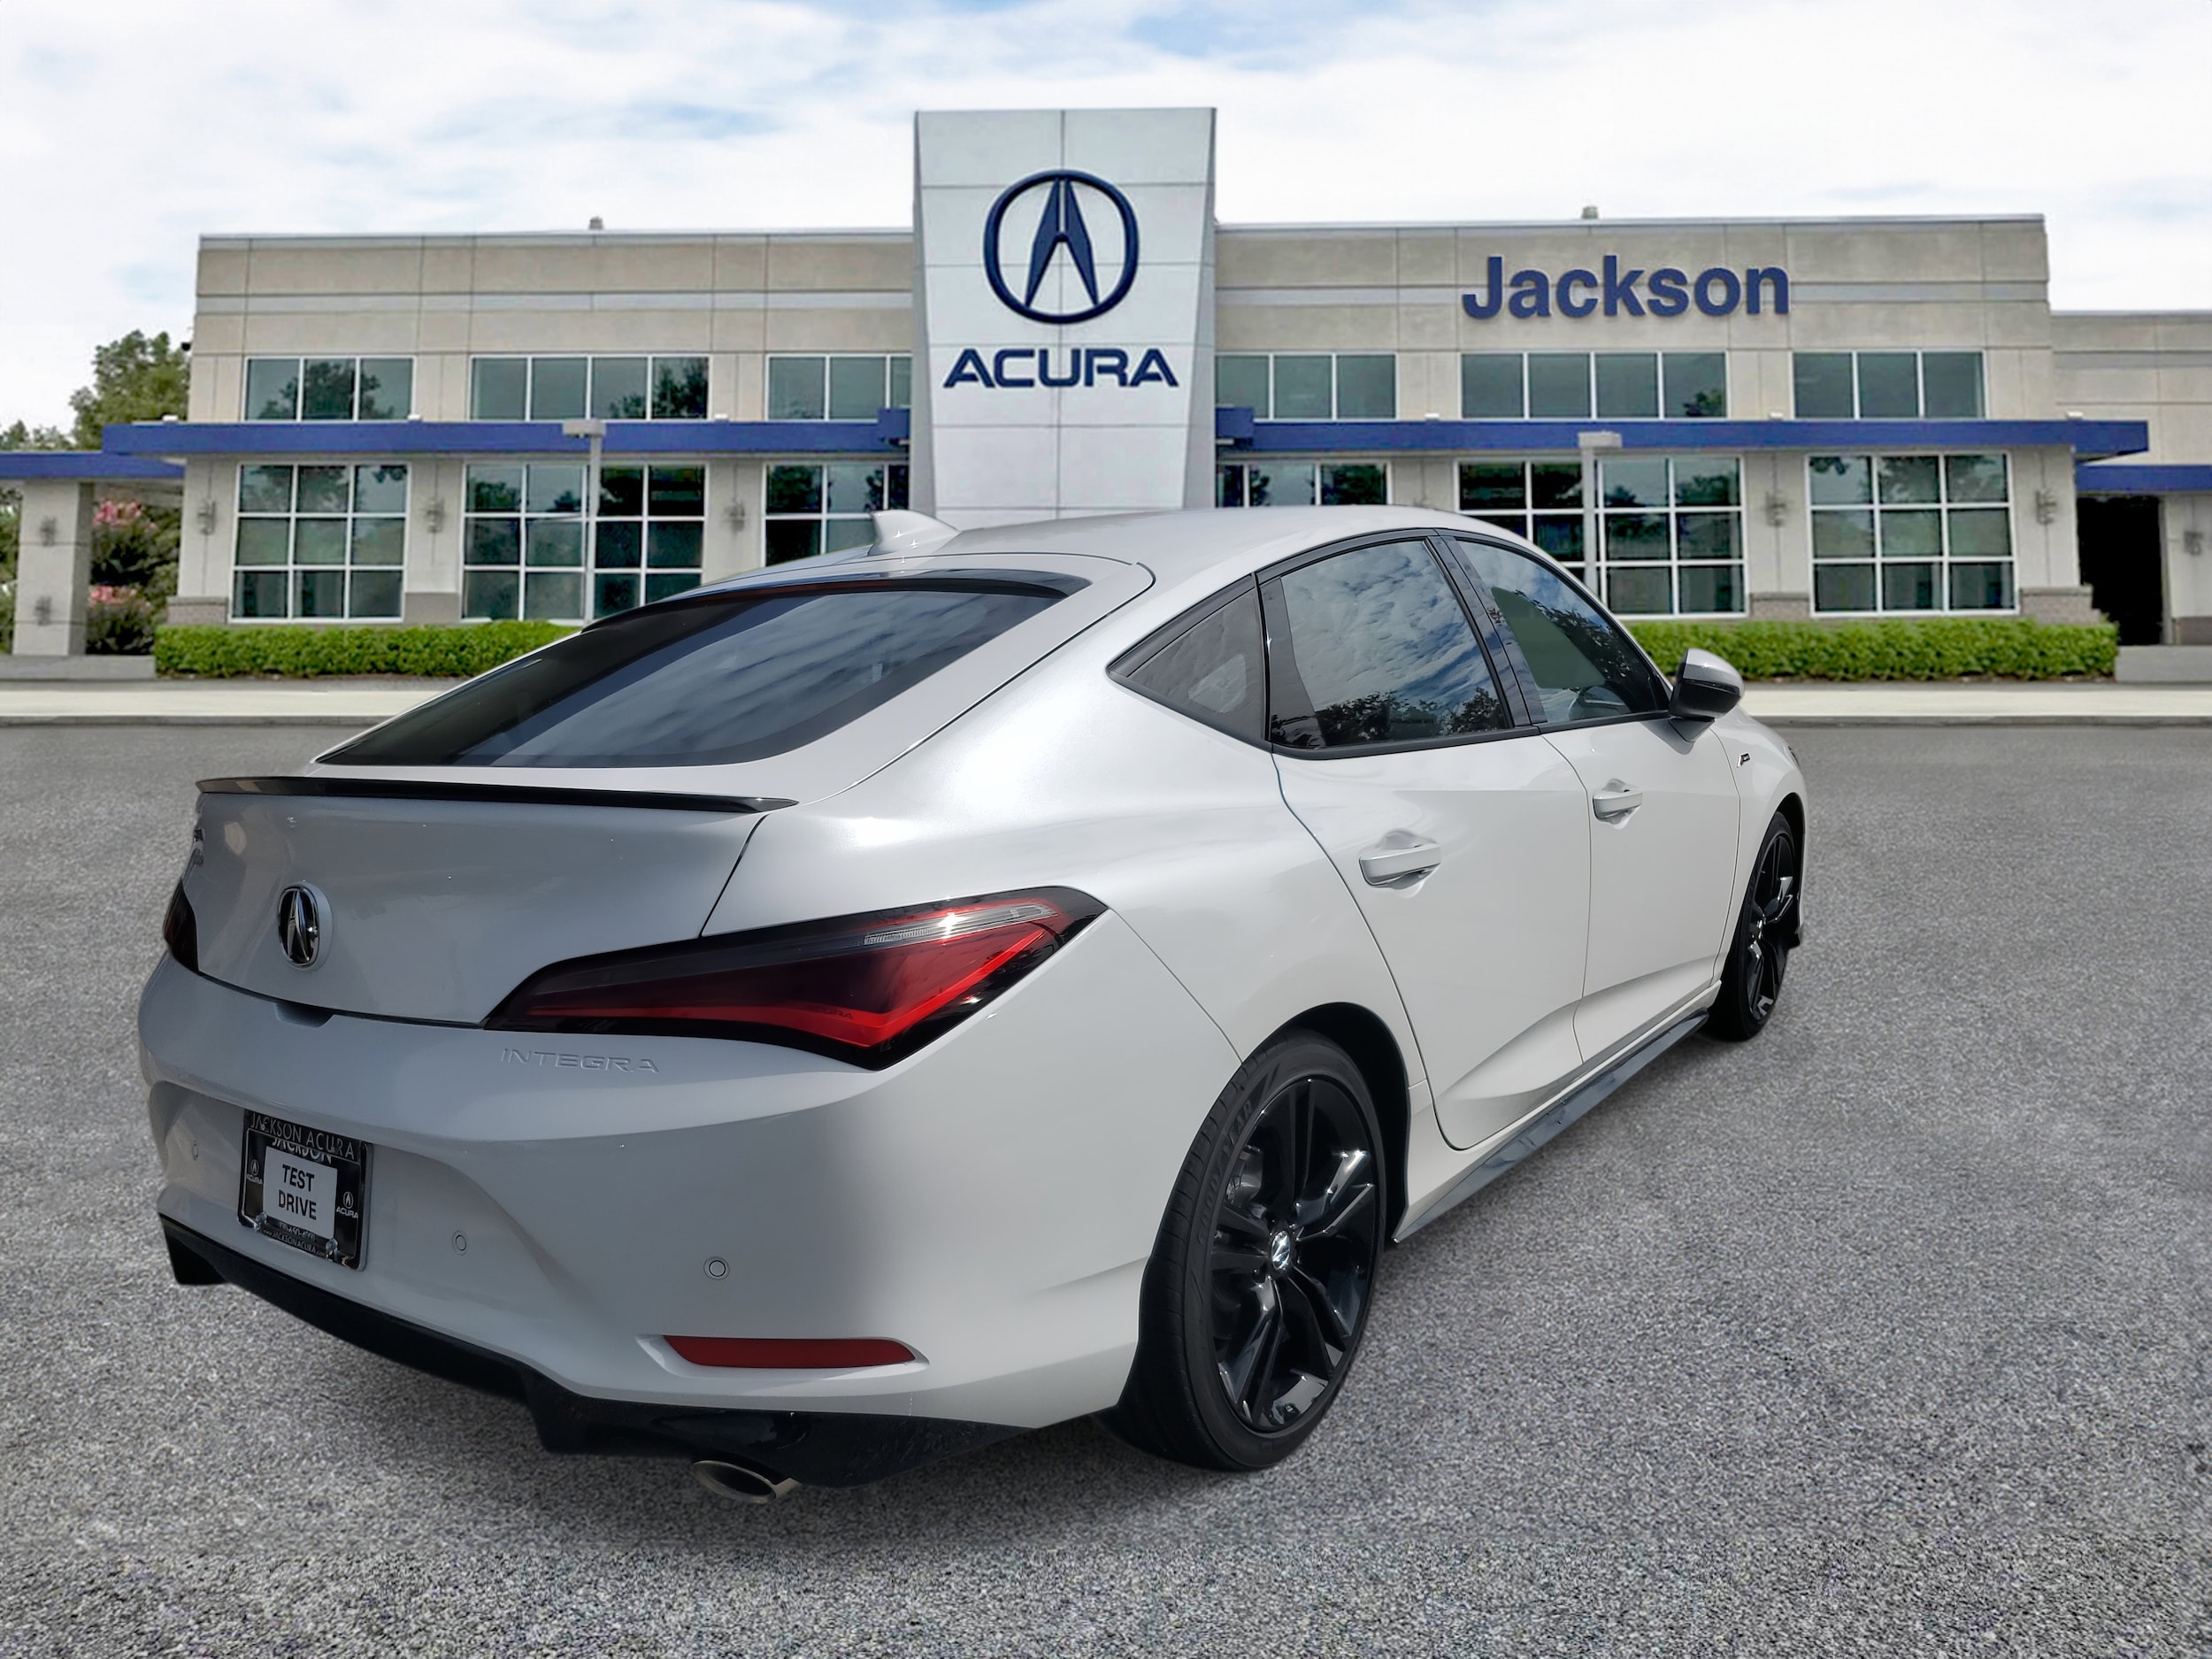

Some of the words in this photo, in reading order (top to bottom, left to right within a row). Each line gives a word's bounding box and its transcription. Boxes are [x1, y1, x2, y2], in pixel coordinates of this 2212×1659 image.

[1462, 255, 1790, 319] Jackson
[943, 348, 1179, 388] ACURA
[501, 1048, 659, 1073] INTEGRA
[251, 1112, 303, 1144] JACKSON
[305, 1131, 355, 1160] ACURA
[281, 1164, 315, 1192] TEST
[278, 1189, 317, 1220] DRIVE
[336, 1206, 358, 1218] ACURA
